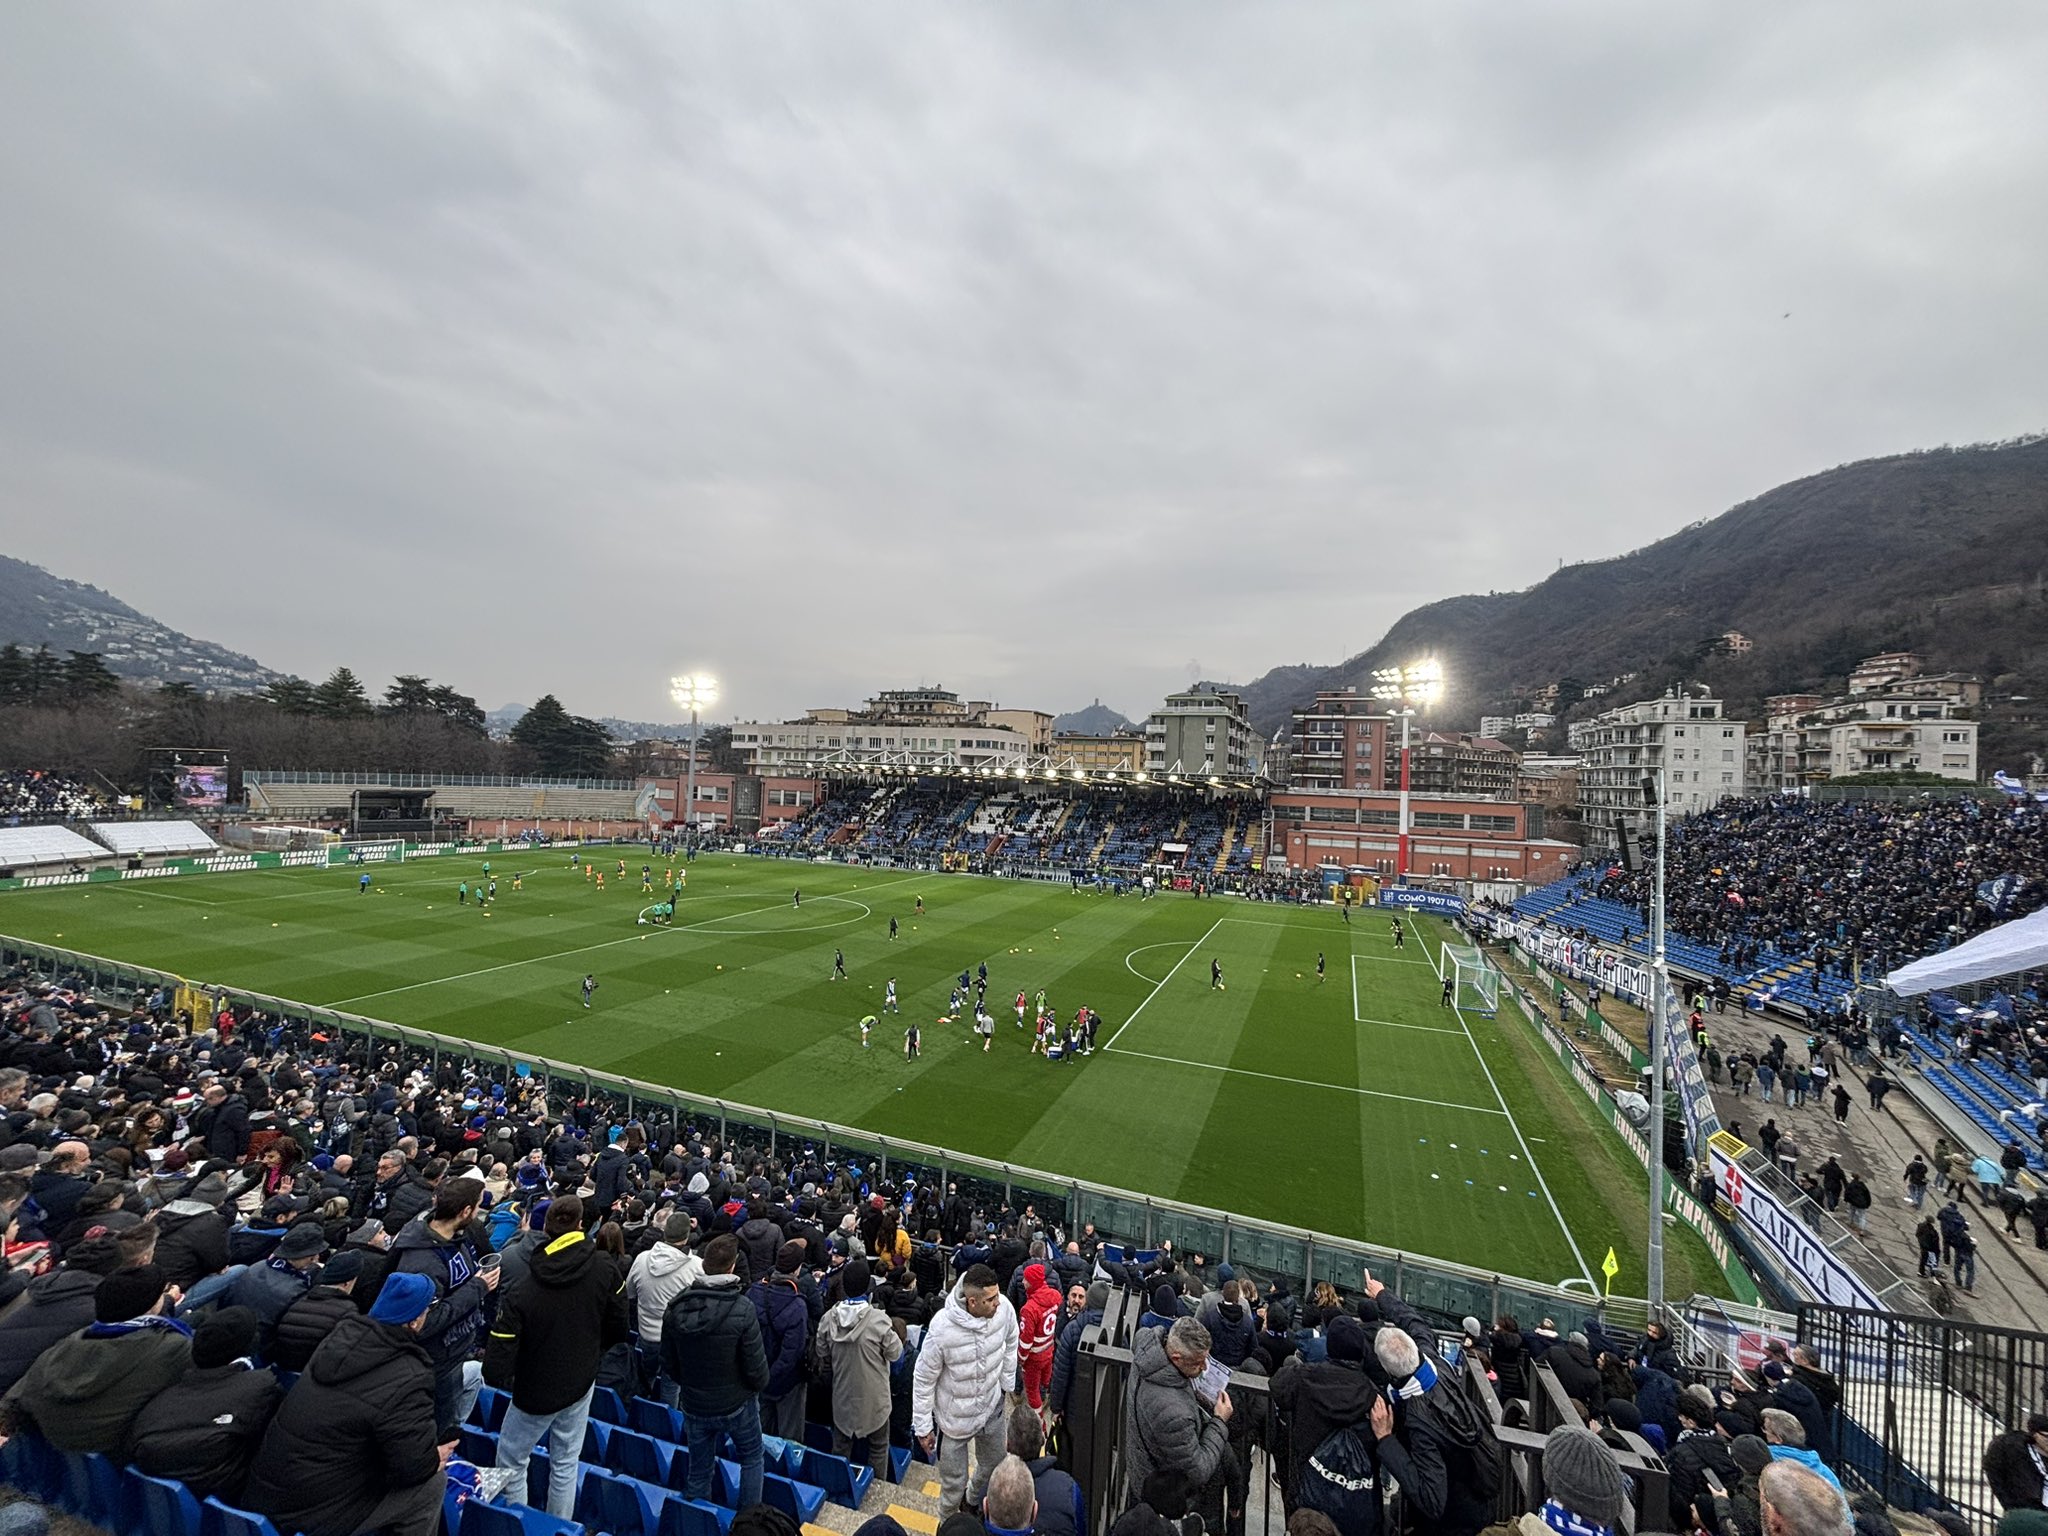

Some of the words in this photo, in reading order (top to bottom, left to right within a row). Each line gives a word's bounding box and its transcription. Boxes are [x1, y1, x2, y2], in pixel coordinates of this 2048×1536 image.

[121, 866, 179, 879] TEMPOCASA
[207, 861, 258, 872] TEMPOCASA
[23, 873, 90, 887] TEMPOCASA
[1397, 894, 1426, 902] COMO
[1427, 896, 1446, 906] 1907
[1614, 1109, 1650, 1169] TEMPOCASA
[1668, 1182, 1729, 1271] TEMPOCASA
[1750, 1196, 1832, 1296] CARICA
[1308, 1455, 1374, 1491] SKECHERS
